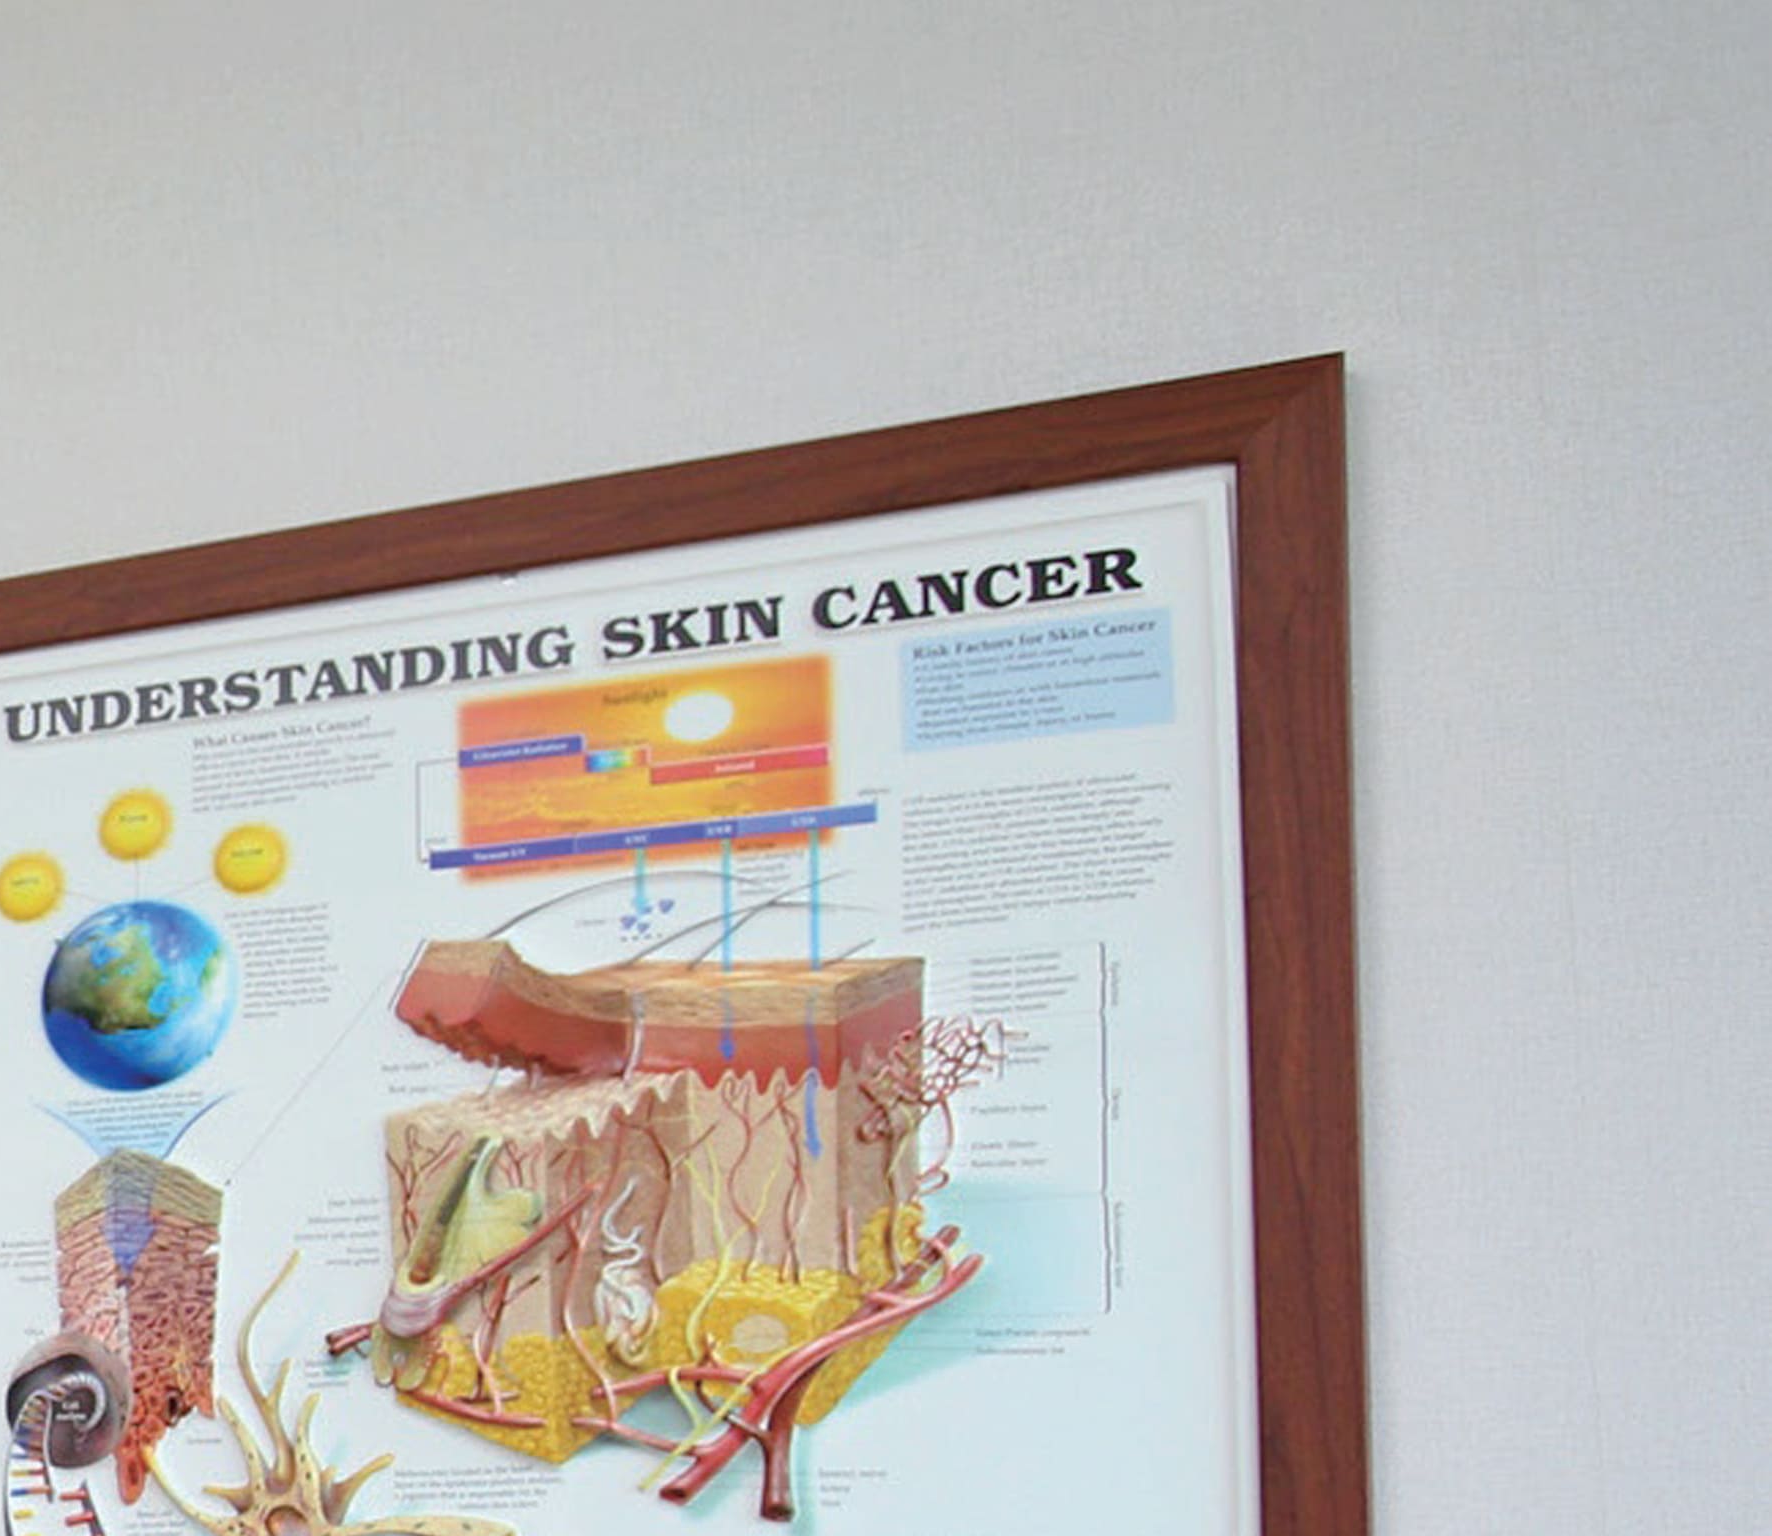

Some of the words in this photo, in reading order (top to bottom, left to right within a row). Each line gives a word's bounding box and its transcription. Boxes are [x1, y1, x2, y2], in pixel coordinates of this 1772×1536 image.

[4, 626, 575, 743] UNDERSTANDING
[601, 594, 786, 660] SKIN
[811, 547, 1143, 630] CANCER
[912, 645, 948, 660] Risk
[955, 638, 1014, 654] Factors
[1019, 633, 1043, 646] for
[1048, 627, 1089, 643] Skin
[1093, 620, 1156, 637] Cancer
[193, 735, 227, 749] What
[280, 725, 312, 737] Skin
[316, 715, 371, 733] Cancer?
